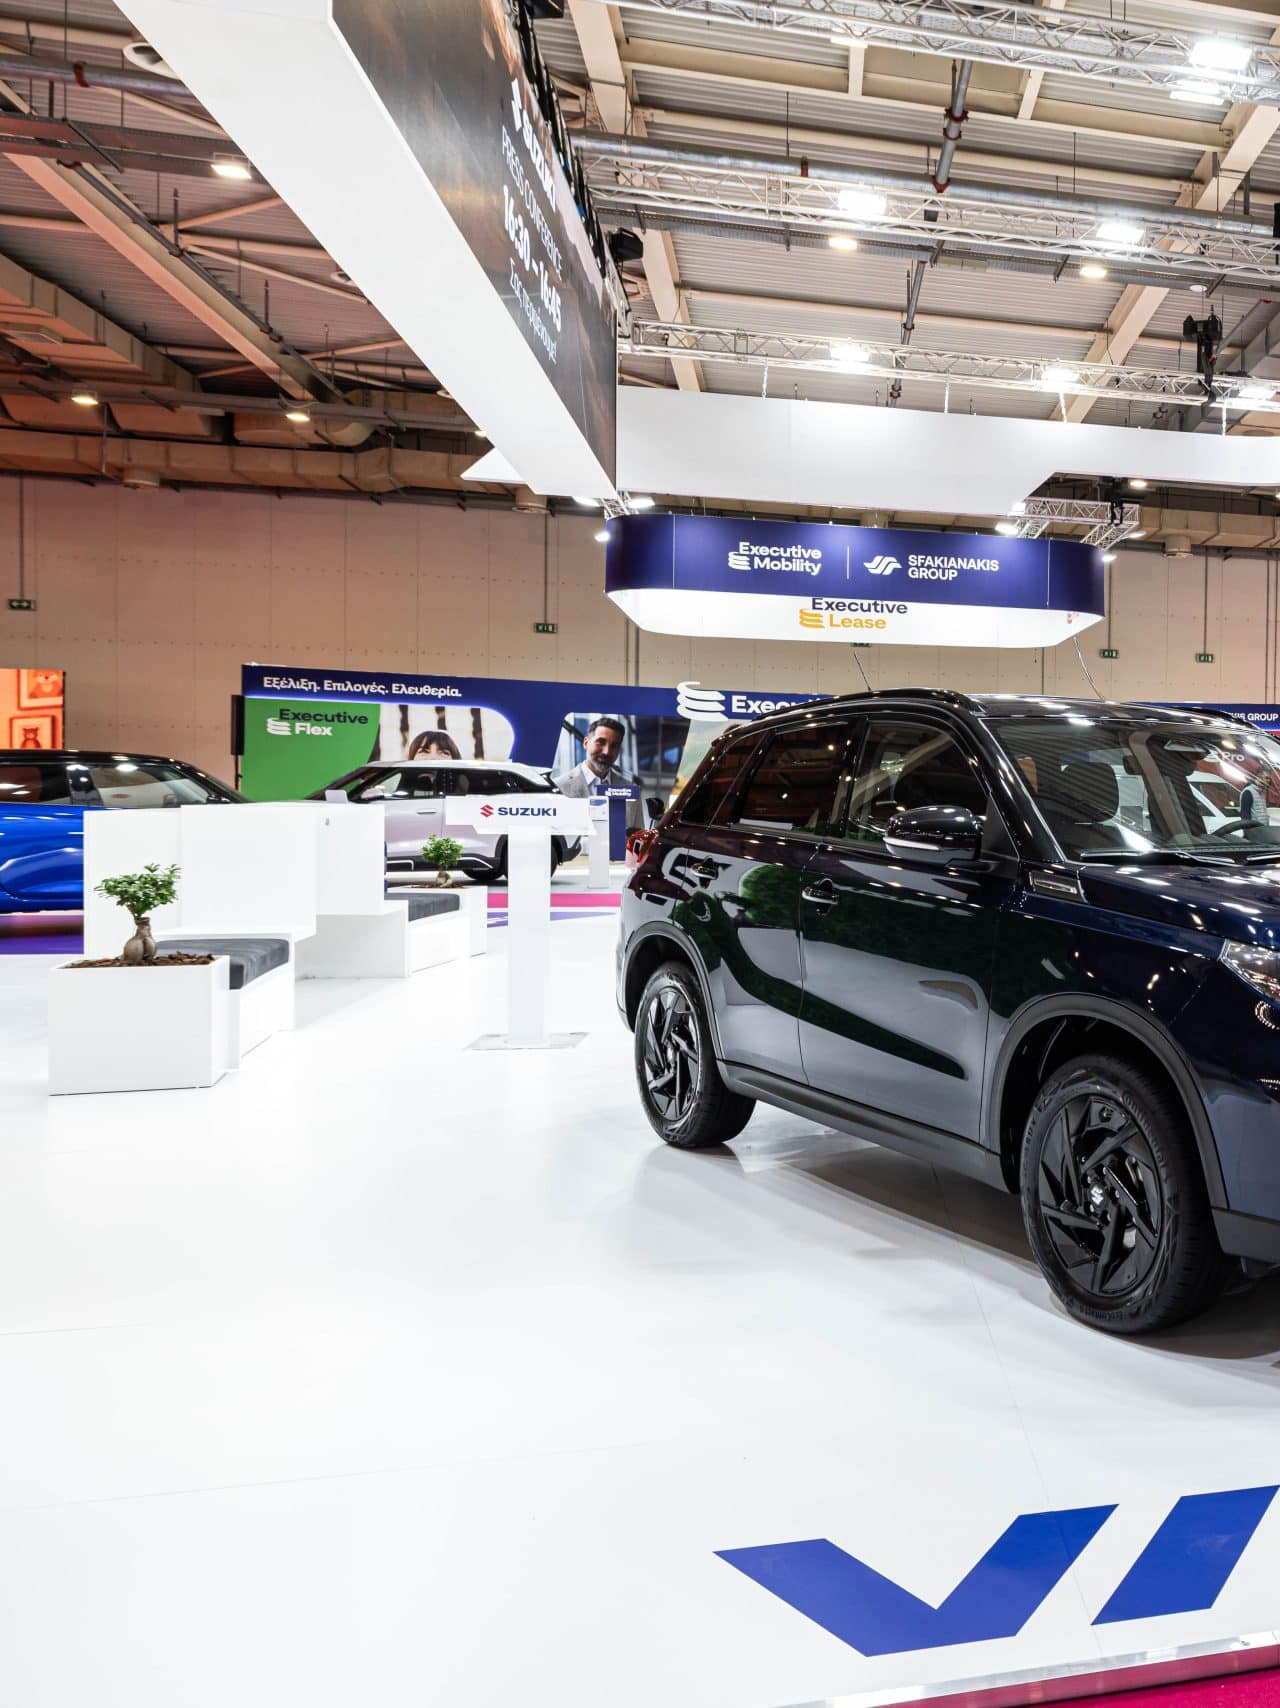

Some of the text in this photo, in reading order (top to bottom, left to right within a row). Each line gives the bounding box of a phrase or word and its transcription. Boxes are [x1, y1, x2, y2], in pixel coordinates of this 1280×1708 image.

[522, 109, 556, 213] SUZUKI
[502, 124, 562, 282] PRESS CONFERENCE
[503, 184, 531, 272] 16:30
[539, 260, 561, 332] 16:45
[739, 541, 822, 560] Executive
[753, 556, 821, 576] Mobility
[908, 554, 1000, 572] SFAKIANAKIS
[908, 567, 958, 581] GROUP
[811, 597, 908, 615] Executive
[829, 613, 887, 630] Lease
[263, 676, 463, 698] Εξέλιξη. Επιλογές. Ελευθερία.
[279, 708, 369, 725] Executive
[1247, 713, 1279, 721] GROUP
[294, 722, 333, 736] Flex
[497, 807, 557, 817] SUZUKI
